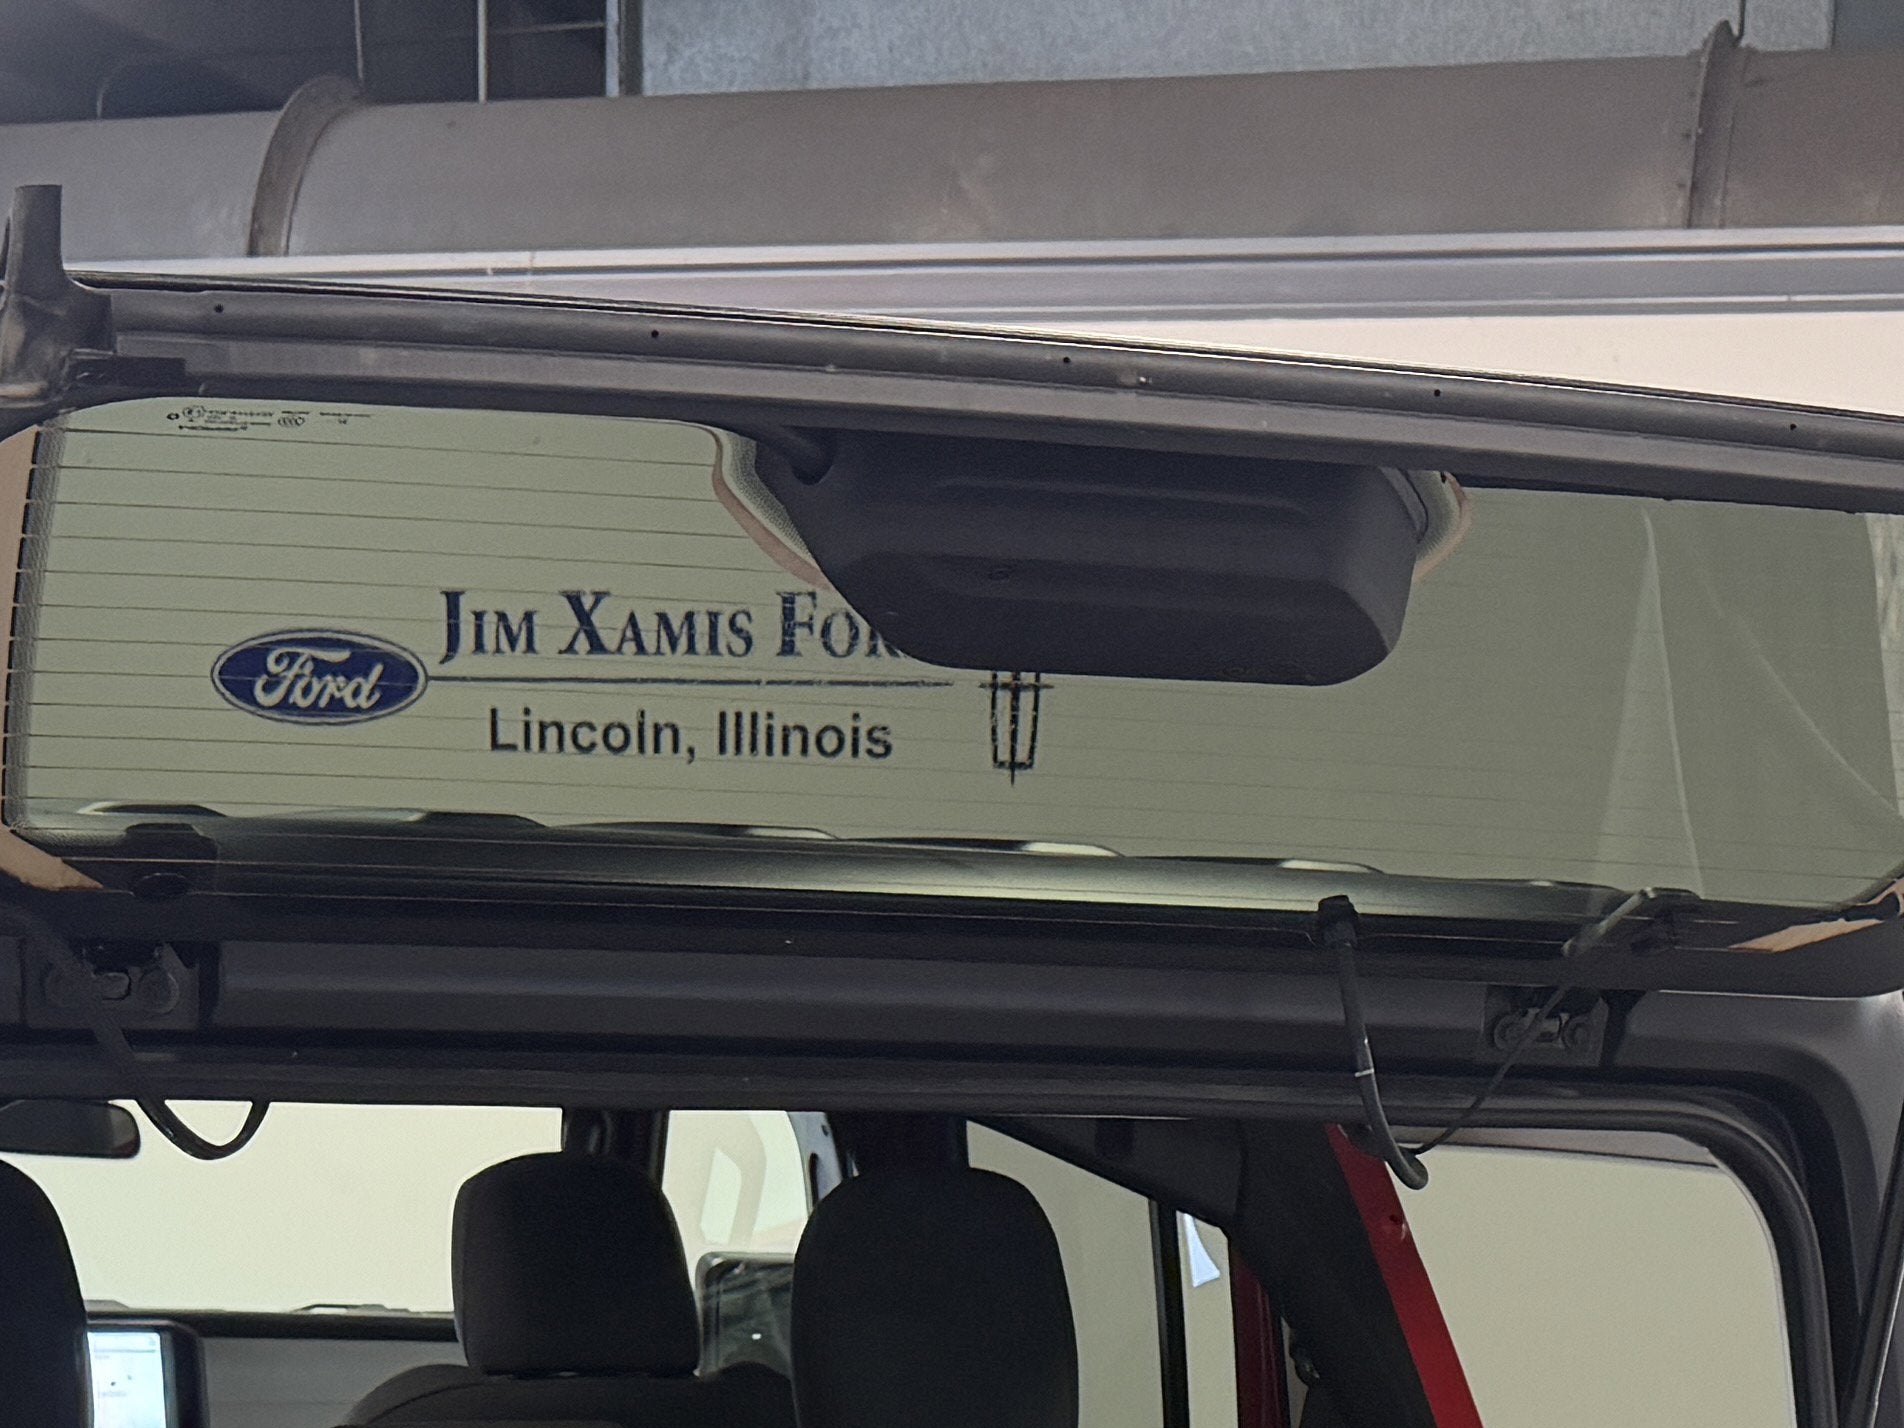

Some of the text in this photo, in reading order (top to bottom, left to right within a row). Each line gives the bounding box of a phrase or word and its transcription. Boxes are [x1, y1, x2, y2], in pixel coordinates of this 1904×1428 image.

[440, 589, 539, 665] JIM
[558, 590, 755, 659] XAMIS
[252, 648, 382, 712] Ford
[489, 707, 894, 763] Lincoln, Illinois
